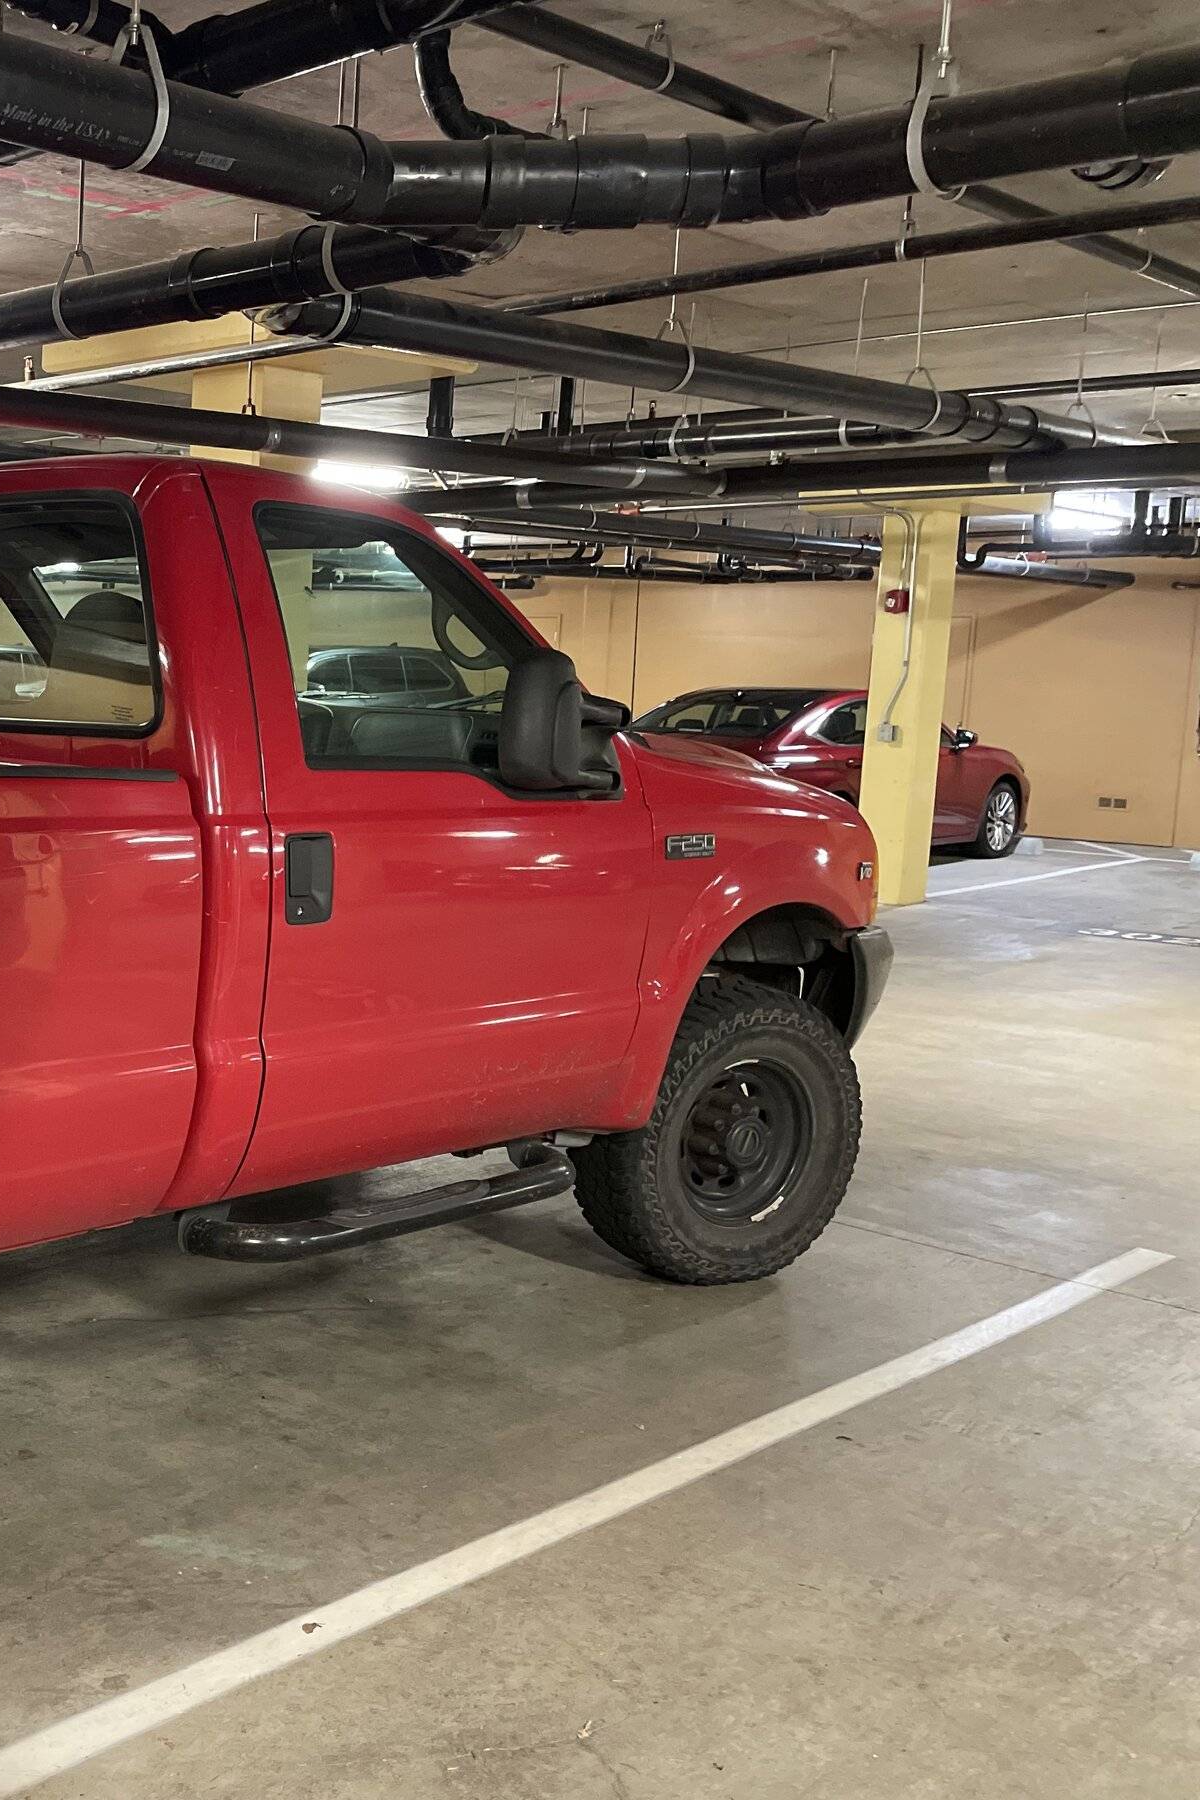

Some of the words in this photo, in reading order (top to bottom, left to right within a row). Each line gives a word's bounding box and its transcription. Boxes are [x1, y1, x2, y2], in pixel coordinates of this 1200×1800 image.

[1, 102, 38, 124] Made
[37, 111, 51, 128] in
[52, 116, 75, 133] the
[75, 121, 104, 142] USA
[667, 834, 715, 852] F250
